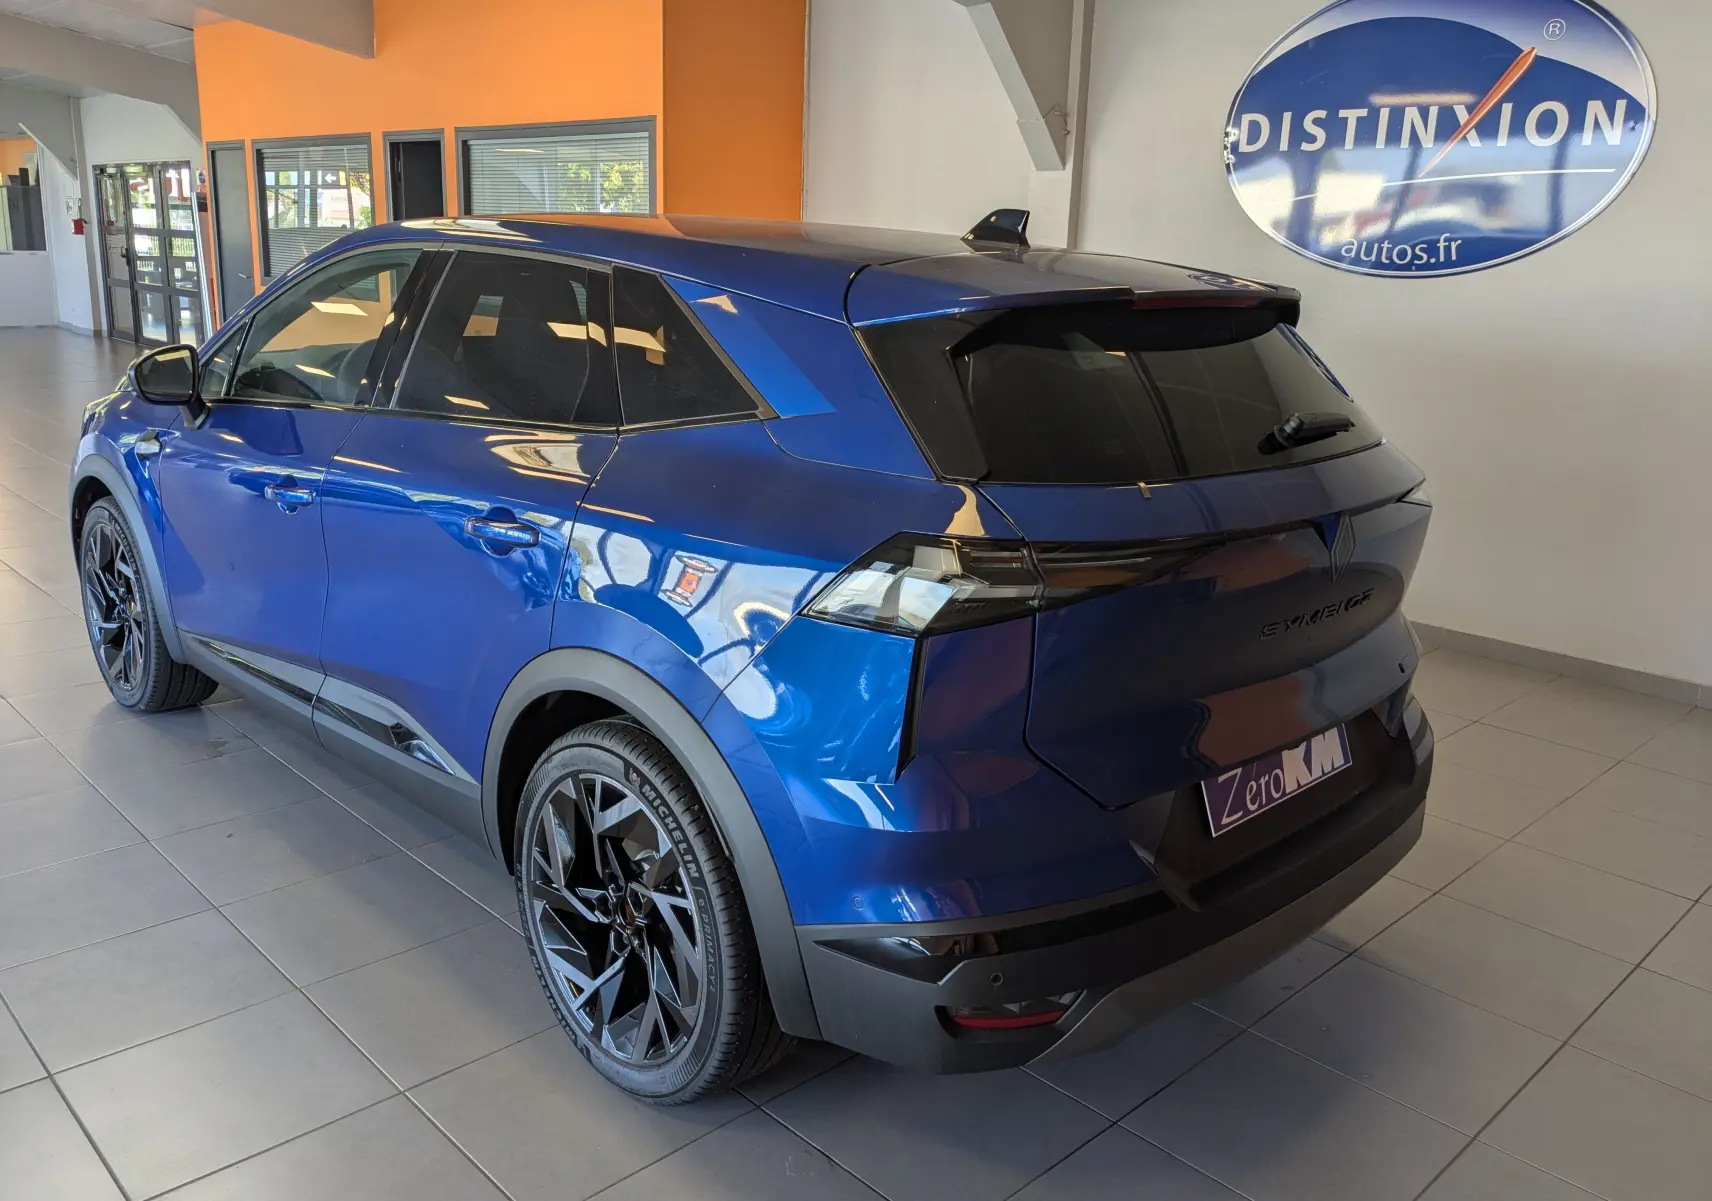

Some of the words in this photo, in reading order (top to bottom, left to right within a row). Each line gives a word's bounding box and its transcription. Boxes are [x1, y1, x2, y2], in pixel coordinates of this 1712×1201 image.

[1237, 99, 1628, 153] DISTINXION
[1340, 233, 1462, 265] autos.fr
[641, 783, 700, 879] MICHELIN
[531, 954, 577, 1042] MICHELIN
